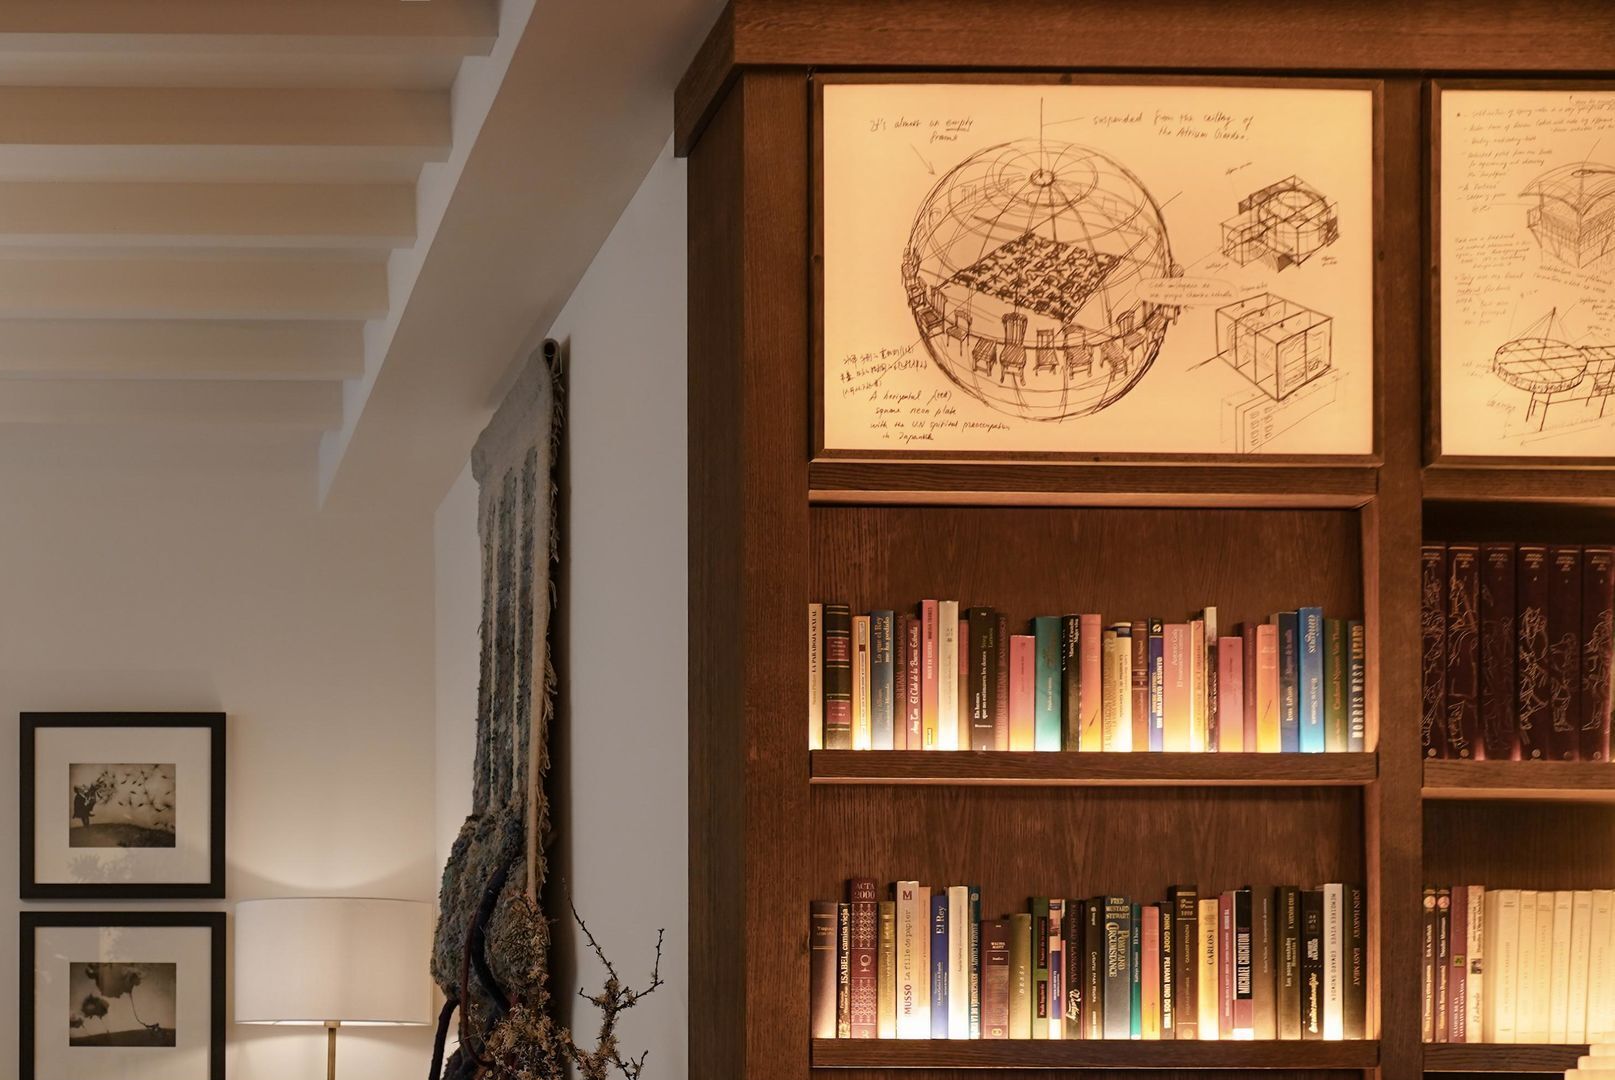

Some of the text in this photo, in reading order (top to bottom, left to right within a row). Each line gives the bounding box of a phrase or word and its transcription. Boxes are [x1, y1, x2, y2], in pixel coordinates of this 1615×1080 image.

[946, 116, 974, 132] empty
[1093, 112, 1143, 127] suspended
[871, 421, 887, 429] with
[875, 616, 884, 664] Lo que el Rey
[910, 627, 918, 648] Estrella
[910, 650, 918, 666] Buena
[1352, 664, 1364, 693] WEST
[910, 683, 919, 695] Club
[910, 696, 919, 705] El
[910, 709, 919, 720] Tan
[1352, 697, 1364, 738] MORRIS
[854, 891, 876, 899] 2000
[902, 890, 912, 900] M
[1352, 890, 1360, 910] JOHN
[841, 909, 849, 926] vieja
[936, 906, 947, 935] El Rey
[905, 939, 911, 948] de
[841, 952, 849, 984] ISABEL,
[1238, 933, 1250, 994] MICHAEL CRICHTON
[905, 972, 911, 981] La
[904, 985, 912, 1015] MUSSO
